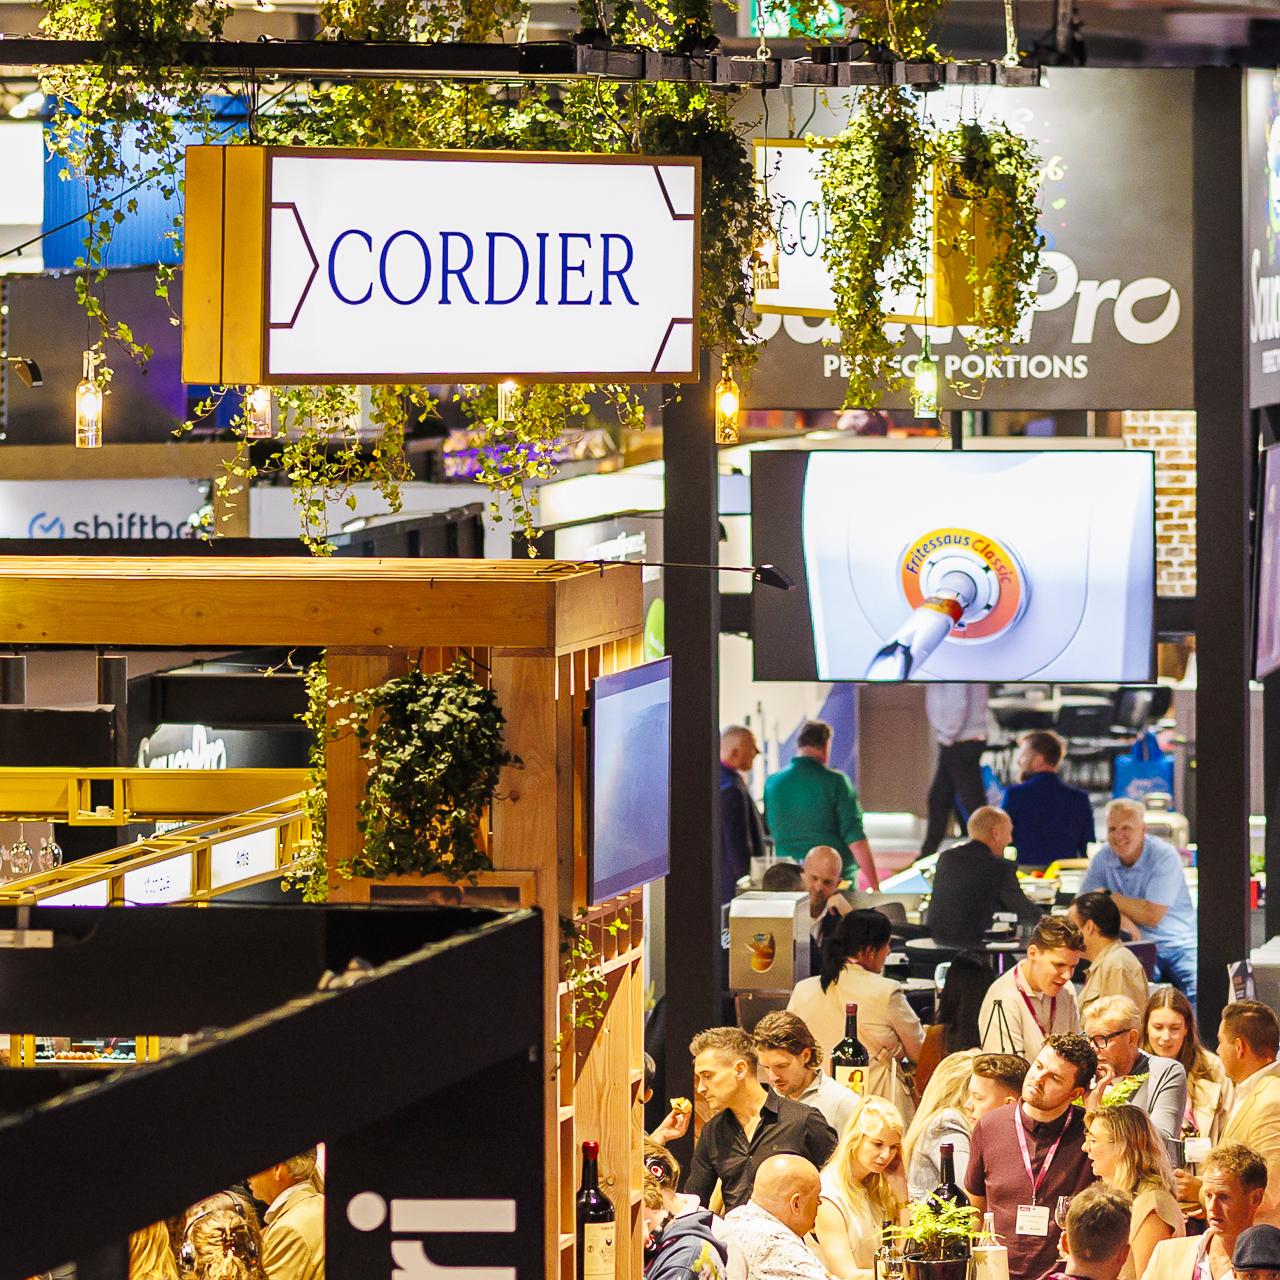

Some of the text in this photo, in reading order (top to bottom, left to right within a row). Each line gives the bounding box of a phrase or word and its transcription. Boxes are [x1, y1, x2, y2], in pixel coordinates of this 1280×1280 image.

[328, 229, 640, 306] CORDIER
[823, 354, 1088, 379] PEEC PORTIONS
[906, 534, 1014, 584] Fritessaus Classic
